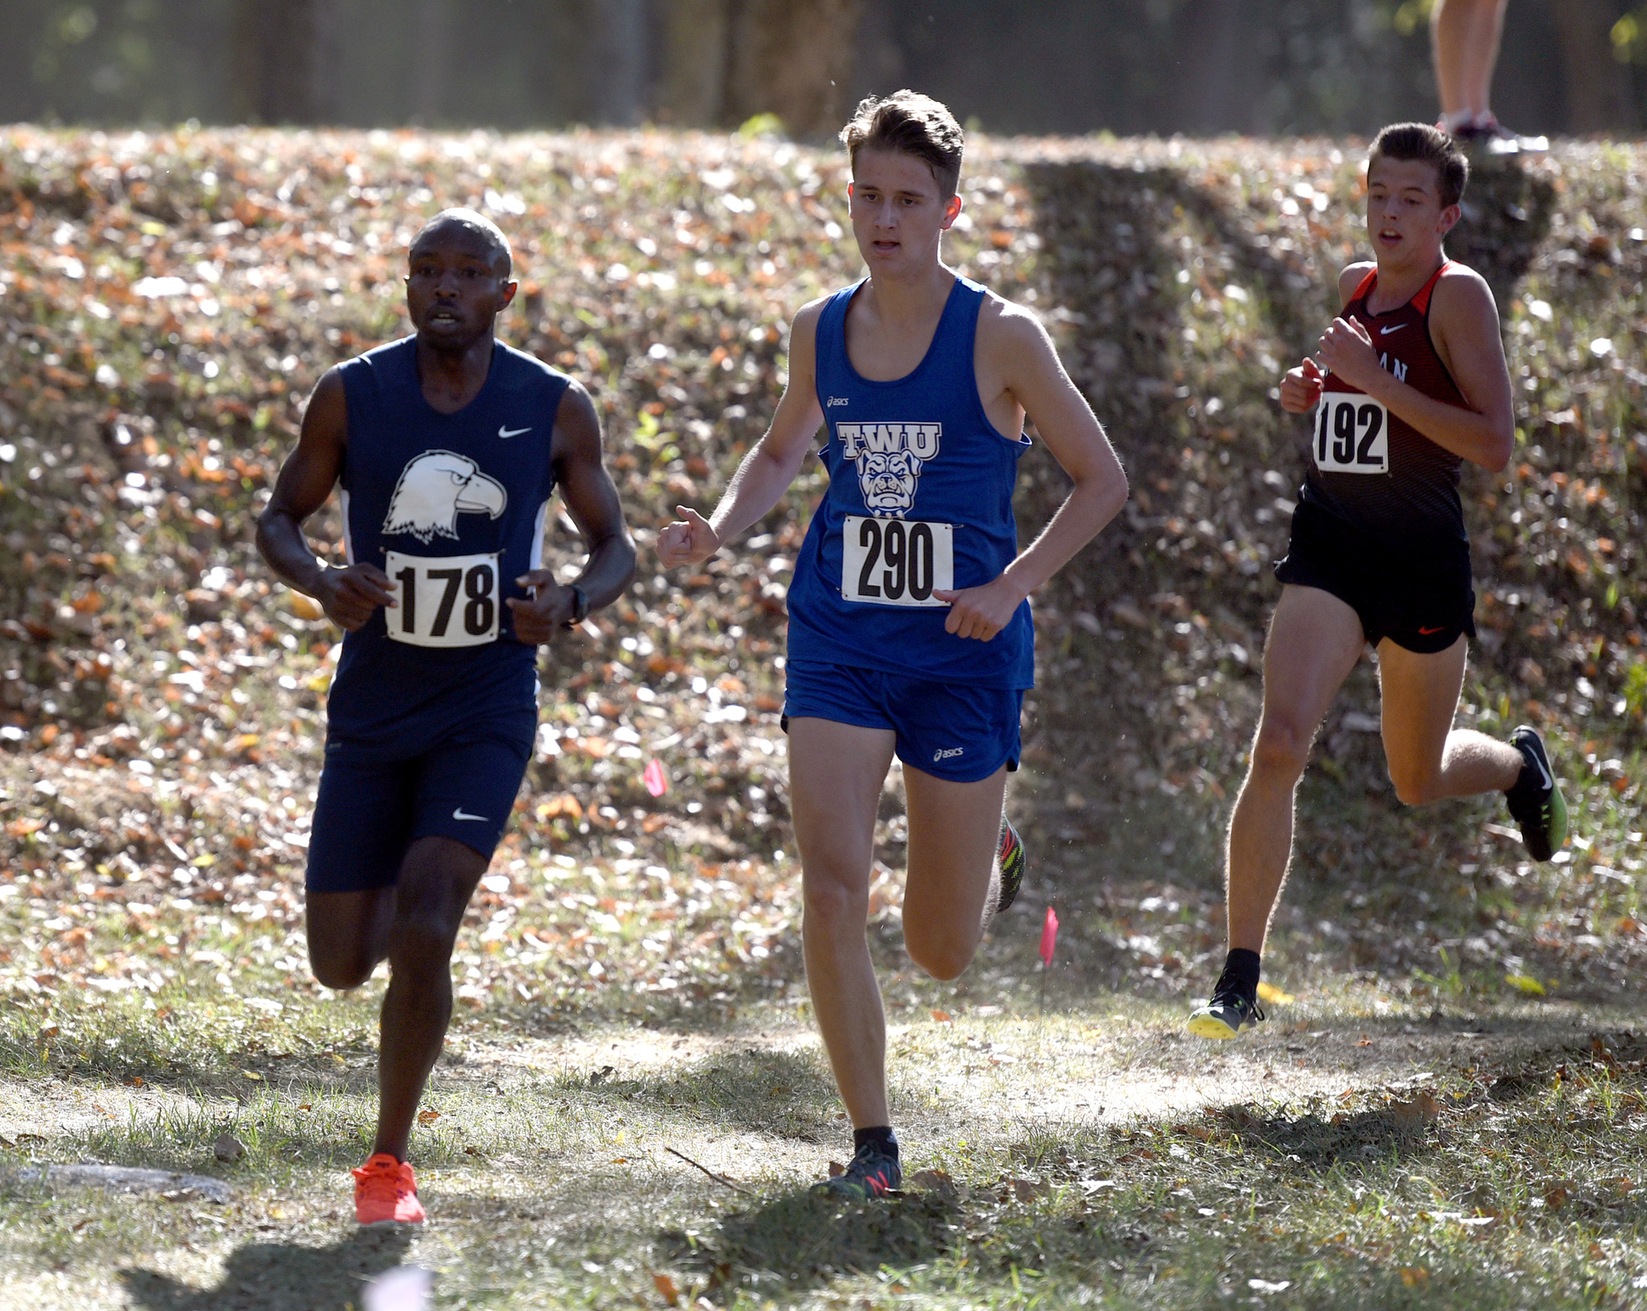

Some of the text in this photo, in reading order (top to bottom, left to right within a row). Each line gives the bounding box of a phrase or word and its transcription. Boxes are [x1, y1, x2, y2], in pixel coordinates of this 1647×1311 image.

[835, 421, 942, 461] TWU
[1318, 402, 1384, 465] 192
[857, 518, 934, 601] 290
[395, 564, 494, 637] 178
[942, 746, 964, 759] asics
